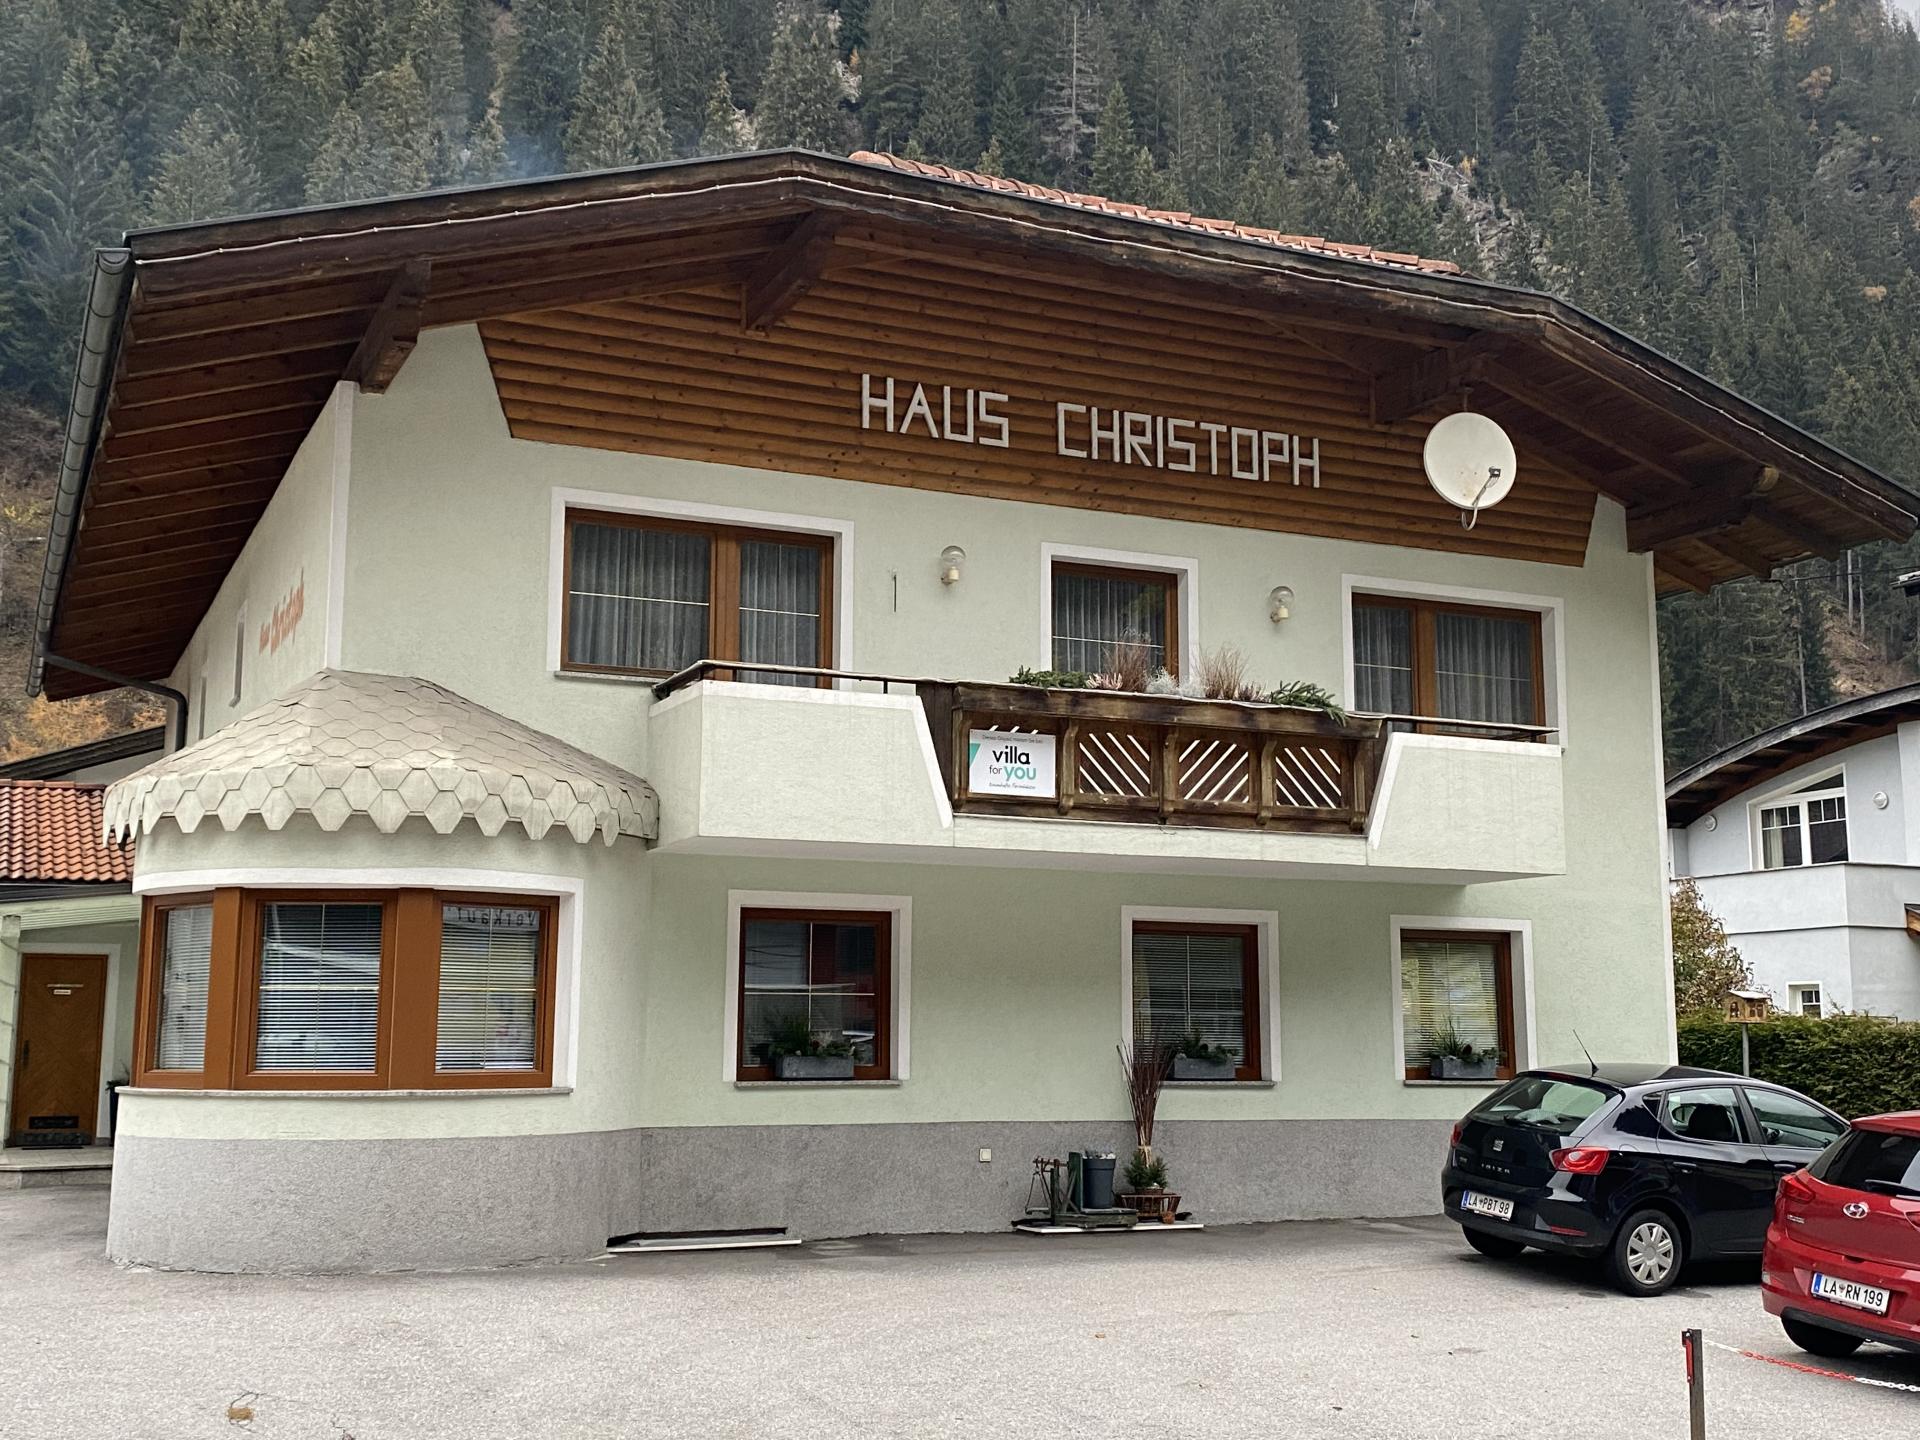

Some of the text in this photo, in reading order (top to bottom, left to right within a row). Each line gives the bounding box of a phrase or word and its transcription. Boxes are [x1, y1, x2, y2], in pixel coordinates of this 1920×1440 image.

[862, 373, 1320, 489] HAUS CHRISTOPH
[992, 745, 1031, 765] villa
[989, 765, 1037, 782] for you
[1498, 1201, 1510, 1215] 98
[1823, 1278, 1884, 1307] LA RN 199
